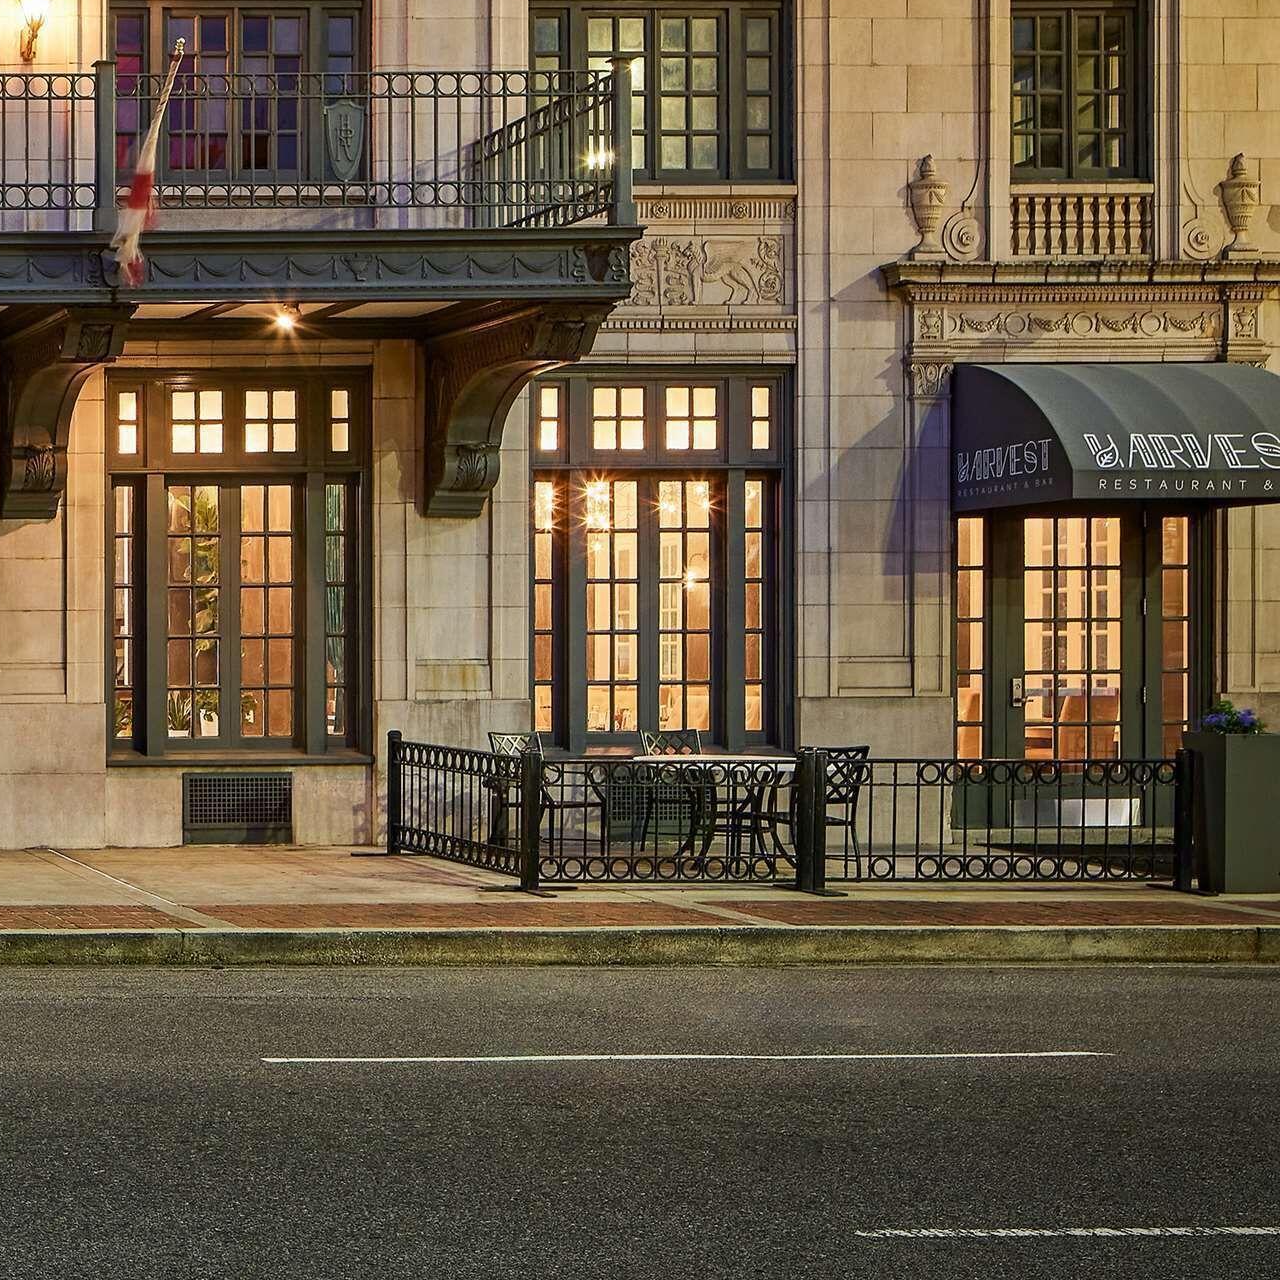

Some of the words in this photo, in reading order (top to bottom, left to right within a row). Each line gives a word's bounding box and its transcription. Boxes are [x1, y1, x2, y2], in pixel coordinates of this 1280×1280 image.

[957, 438, 1052, 483] HARVEST
[957, 482, 1018, 497] RESTAURANT
[1034, 477, 1053, 488] BAR
[1099, 479, 1249, 491] RESTAURANT
[1263, 479, 1274, 491] &
